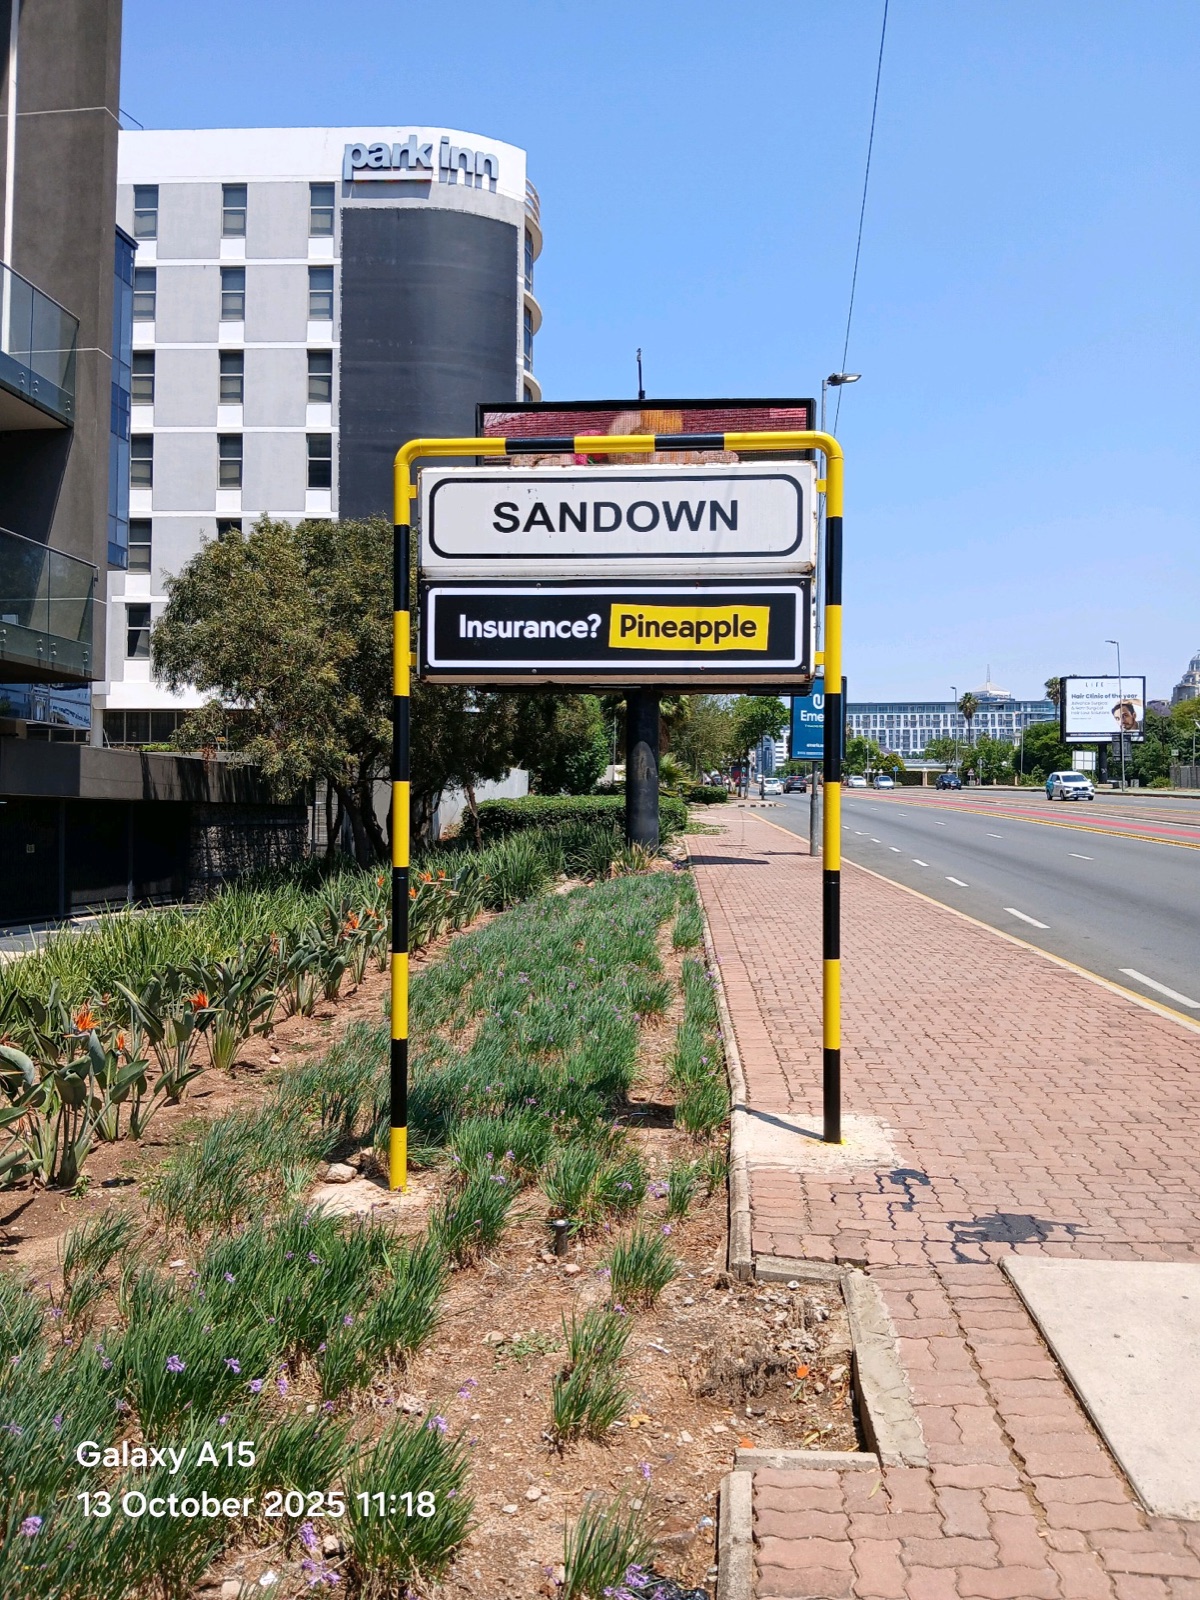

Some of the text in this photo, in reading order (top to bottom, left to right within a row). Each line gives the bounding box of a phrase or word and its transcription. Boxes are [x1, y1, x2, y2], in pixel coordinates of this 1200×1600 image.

[344, 134, 499, 181] park inn
[492, 500, 739, 534] SANDOWN
[459, 613, 757, 644] Insurance? Pineapple
